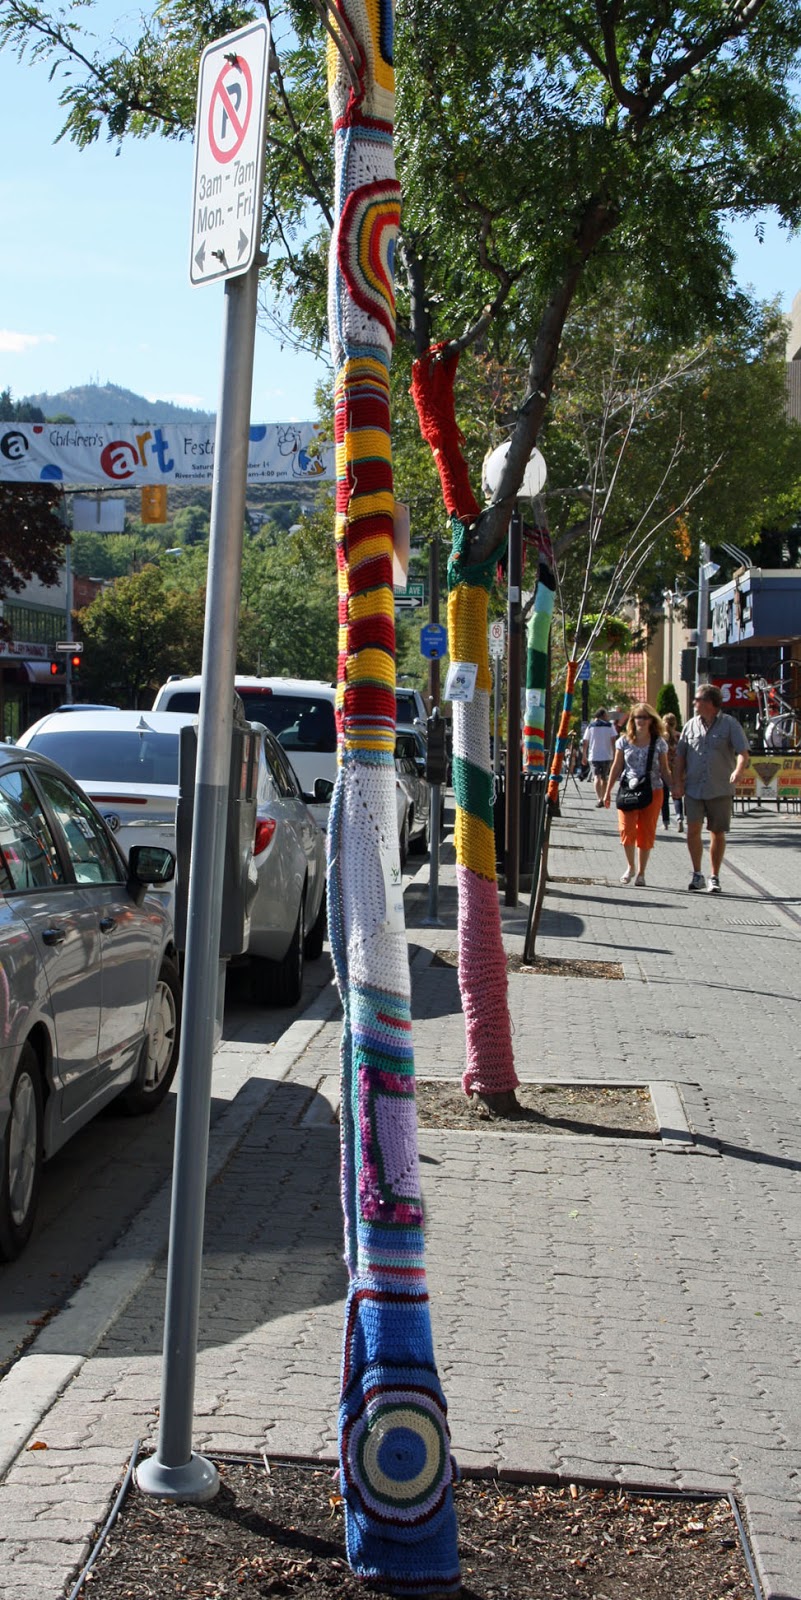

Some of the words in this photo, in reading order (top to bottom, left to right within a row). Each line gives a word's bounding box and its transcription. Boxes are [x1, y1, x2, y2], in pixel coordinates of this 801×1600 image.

[199, 174, 222, 200] 3am
[233, 160, 255, 187] 7am
[197, 205, 225, 234] Mon.
[49, 430, 104, 447] Children's
[101, 428, 175, 479] art
[408, 586, 421, 595] AVE
[456, 676, 466, 684] 96
